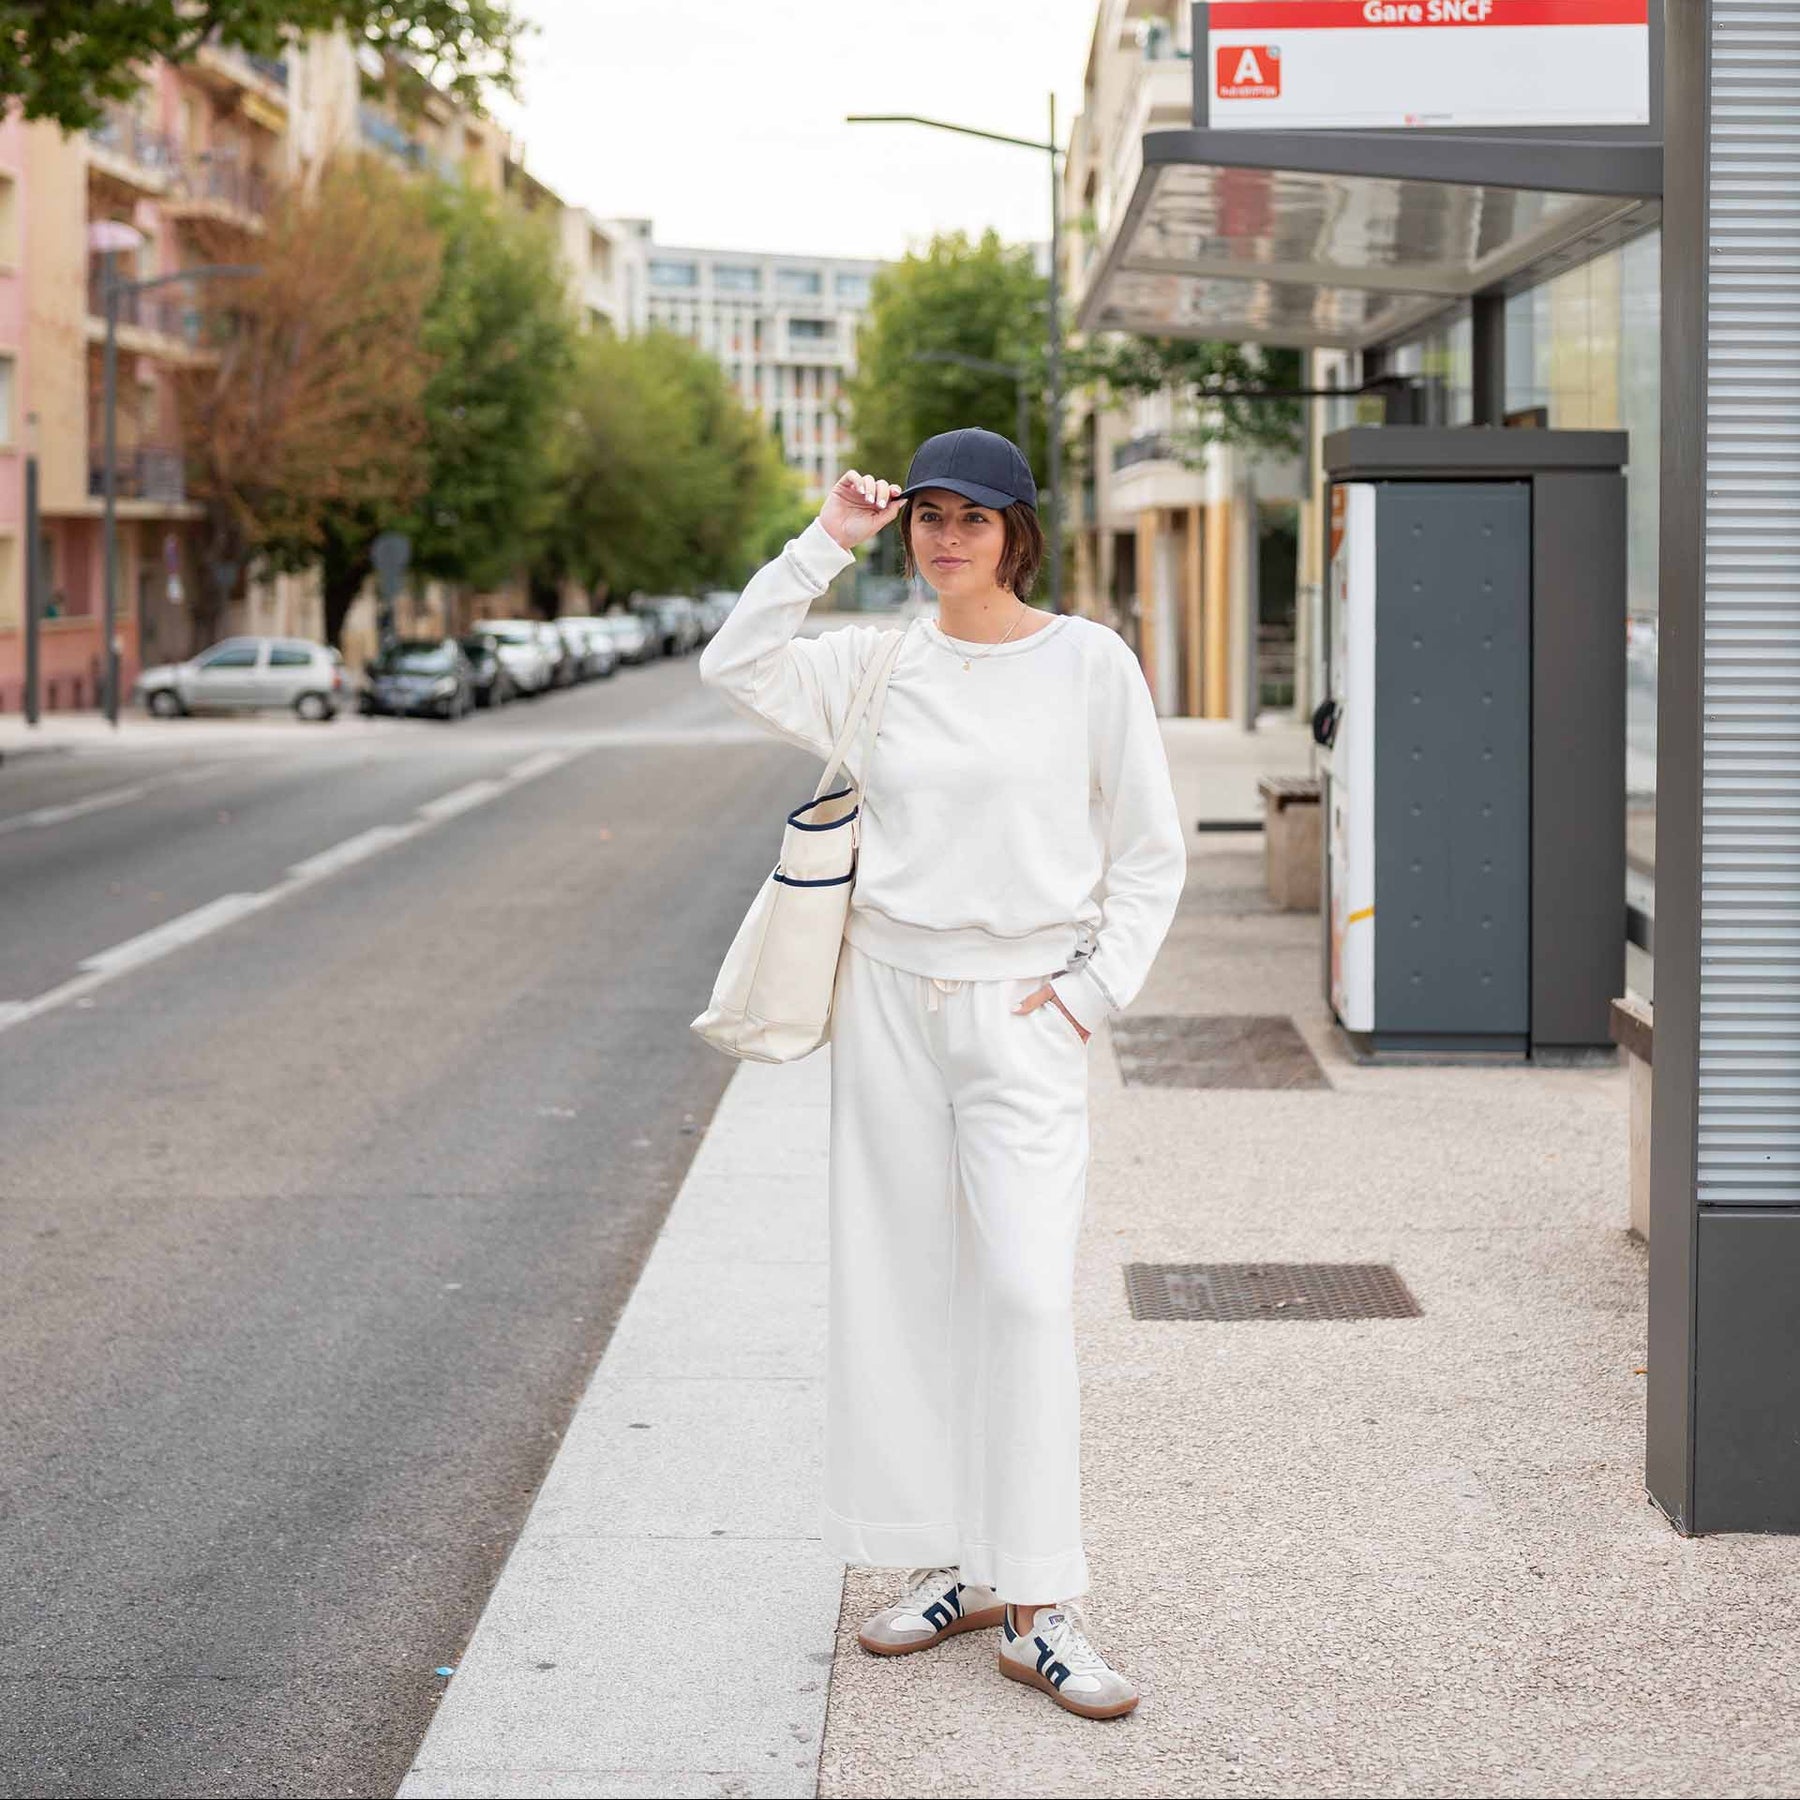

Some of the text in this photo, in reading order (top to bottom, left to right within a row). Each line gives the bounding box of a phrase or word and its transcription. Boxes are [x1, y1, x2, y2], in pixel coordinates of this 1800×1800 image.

[1363, 0, 1493, 22] Gare SNCF
[1232, 48, 1264, 84] A
